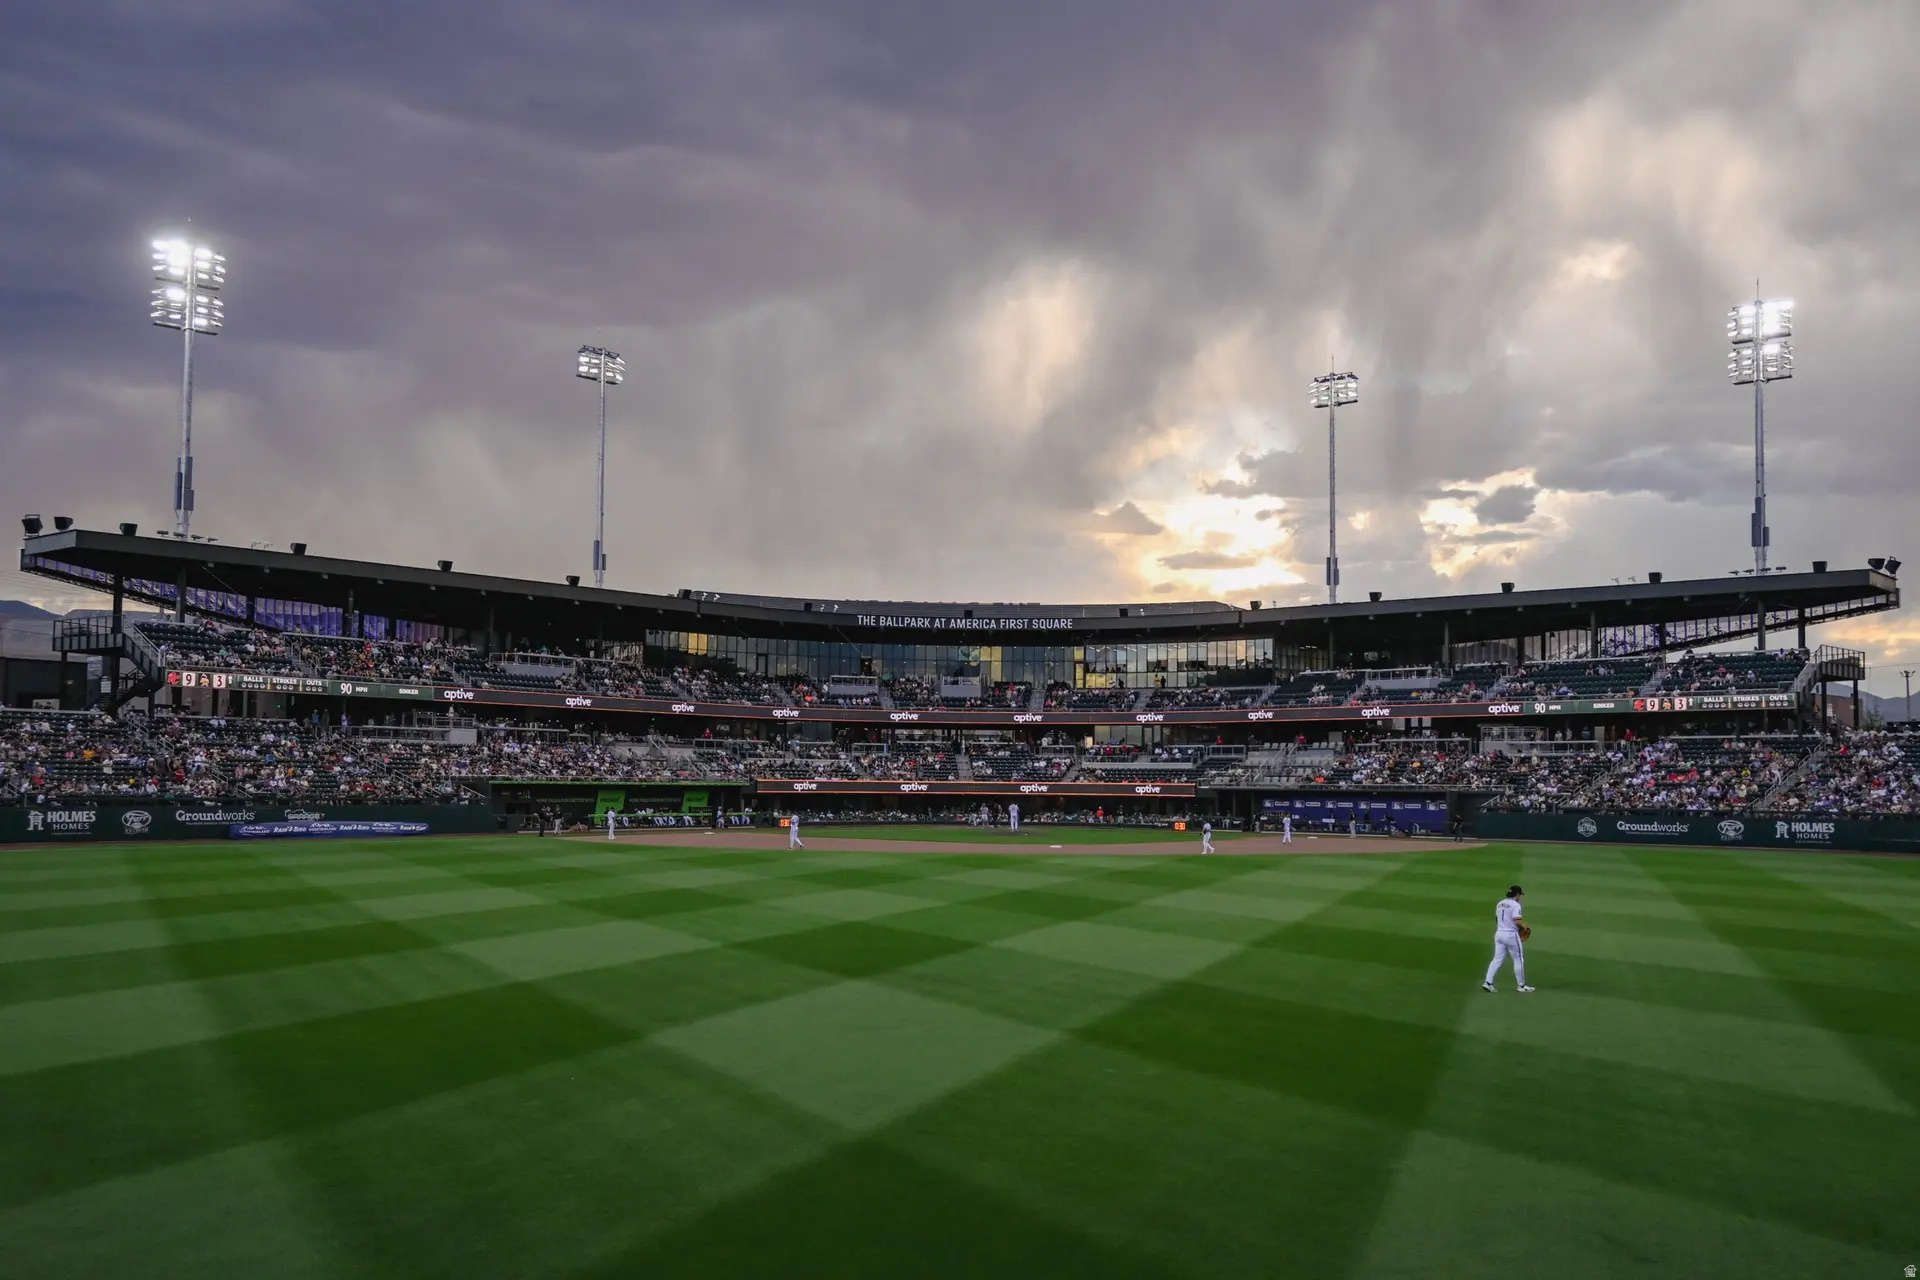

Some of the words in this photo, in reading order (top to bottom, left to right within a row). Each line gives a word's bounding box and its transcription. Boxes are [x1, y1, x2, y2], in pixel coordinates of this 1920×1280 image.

[857, 615, 876, 626] THE
[880, 616, 930, 628] BALLPARK
[934, 618, 946, 628] AT
[950, 619, 997, 629] AMERICA
[1000, 619, 1029, 629] FIRST
[1033, 619, 1073, 630] SQUARE
[185, 673, 192, 685] 9
[216, 675, 222, 687] 3
[340, 683, 352, 694] 90
[444, 688, 474, 701] aptive
[566, 696, 593, 708] aptive
[1650, 700, 1655, 709] 9
[1678, 698, 1684, 708] 3
[672, 702, 695, 714] aptive
[772, 708, 800, 719] aptive
[1361, 706, 1391, 719] aptive
[1488, 702, 1521, 715] aptive
[1534, 703, 1545, 713] 90
[890, 711, 919, 723] aptive
[1014, 712, 1043, 724] aptive
[1136, 712, 1165, 724] aptive
[1248, 709, 1275, 721] aptive
[793, 782, 817, 792] aptive
[900, 782, 927, 793] aptive
[1020, 783, 1048, 794] aptive
[1135, 784, 1161, 795] aptive
[47, 811, 96, 822] HOLMES
[176, 810, 255, 820] Groundworks
[1616, 821, 1688, 832] Groundworks
[1791, 822, 1834, 833] HOLMES
